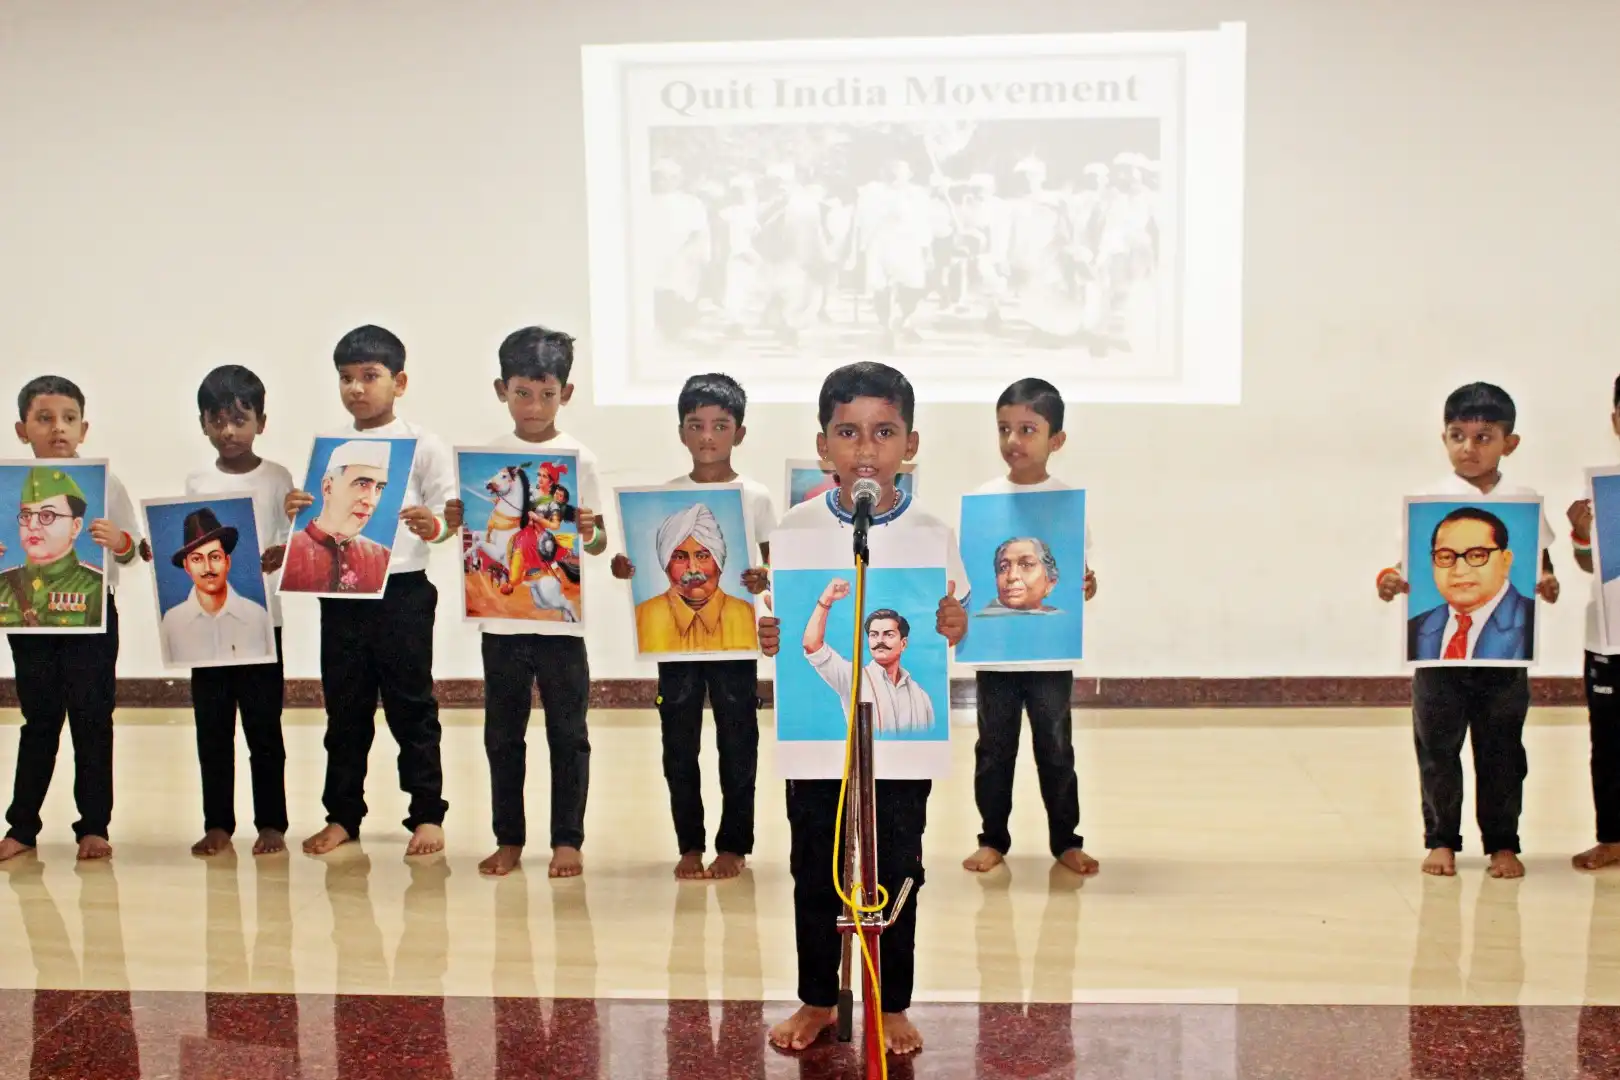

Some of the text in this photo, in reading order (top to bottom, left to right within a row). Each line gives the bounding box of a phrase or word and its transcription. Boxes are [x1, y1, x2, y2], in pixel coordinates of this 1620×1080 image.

[660, 74, 1140, 117] Quit India Movement
